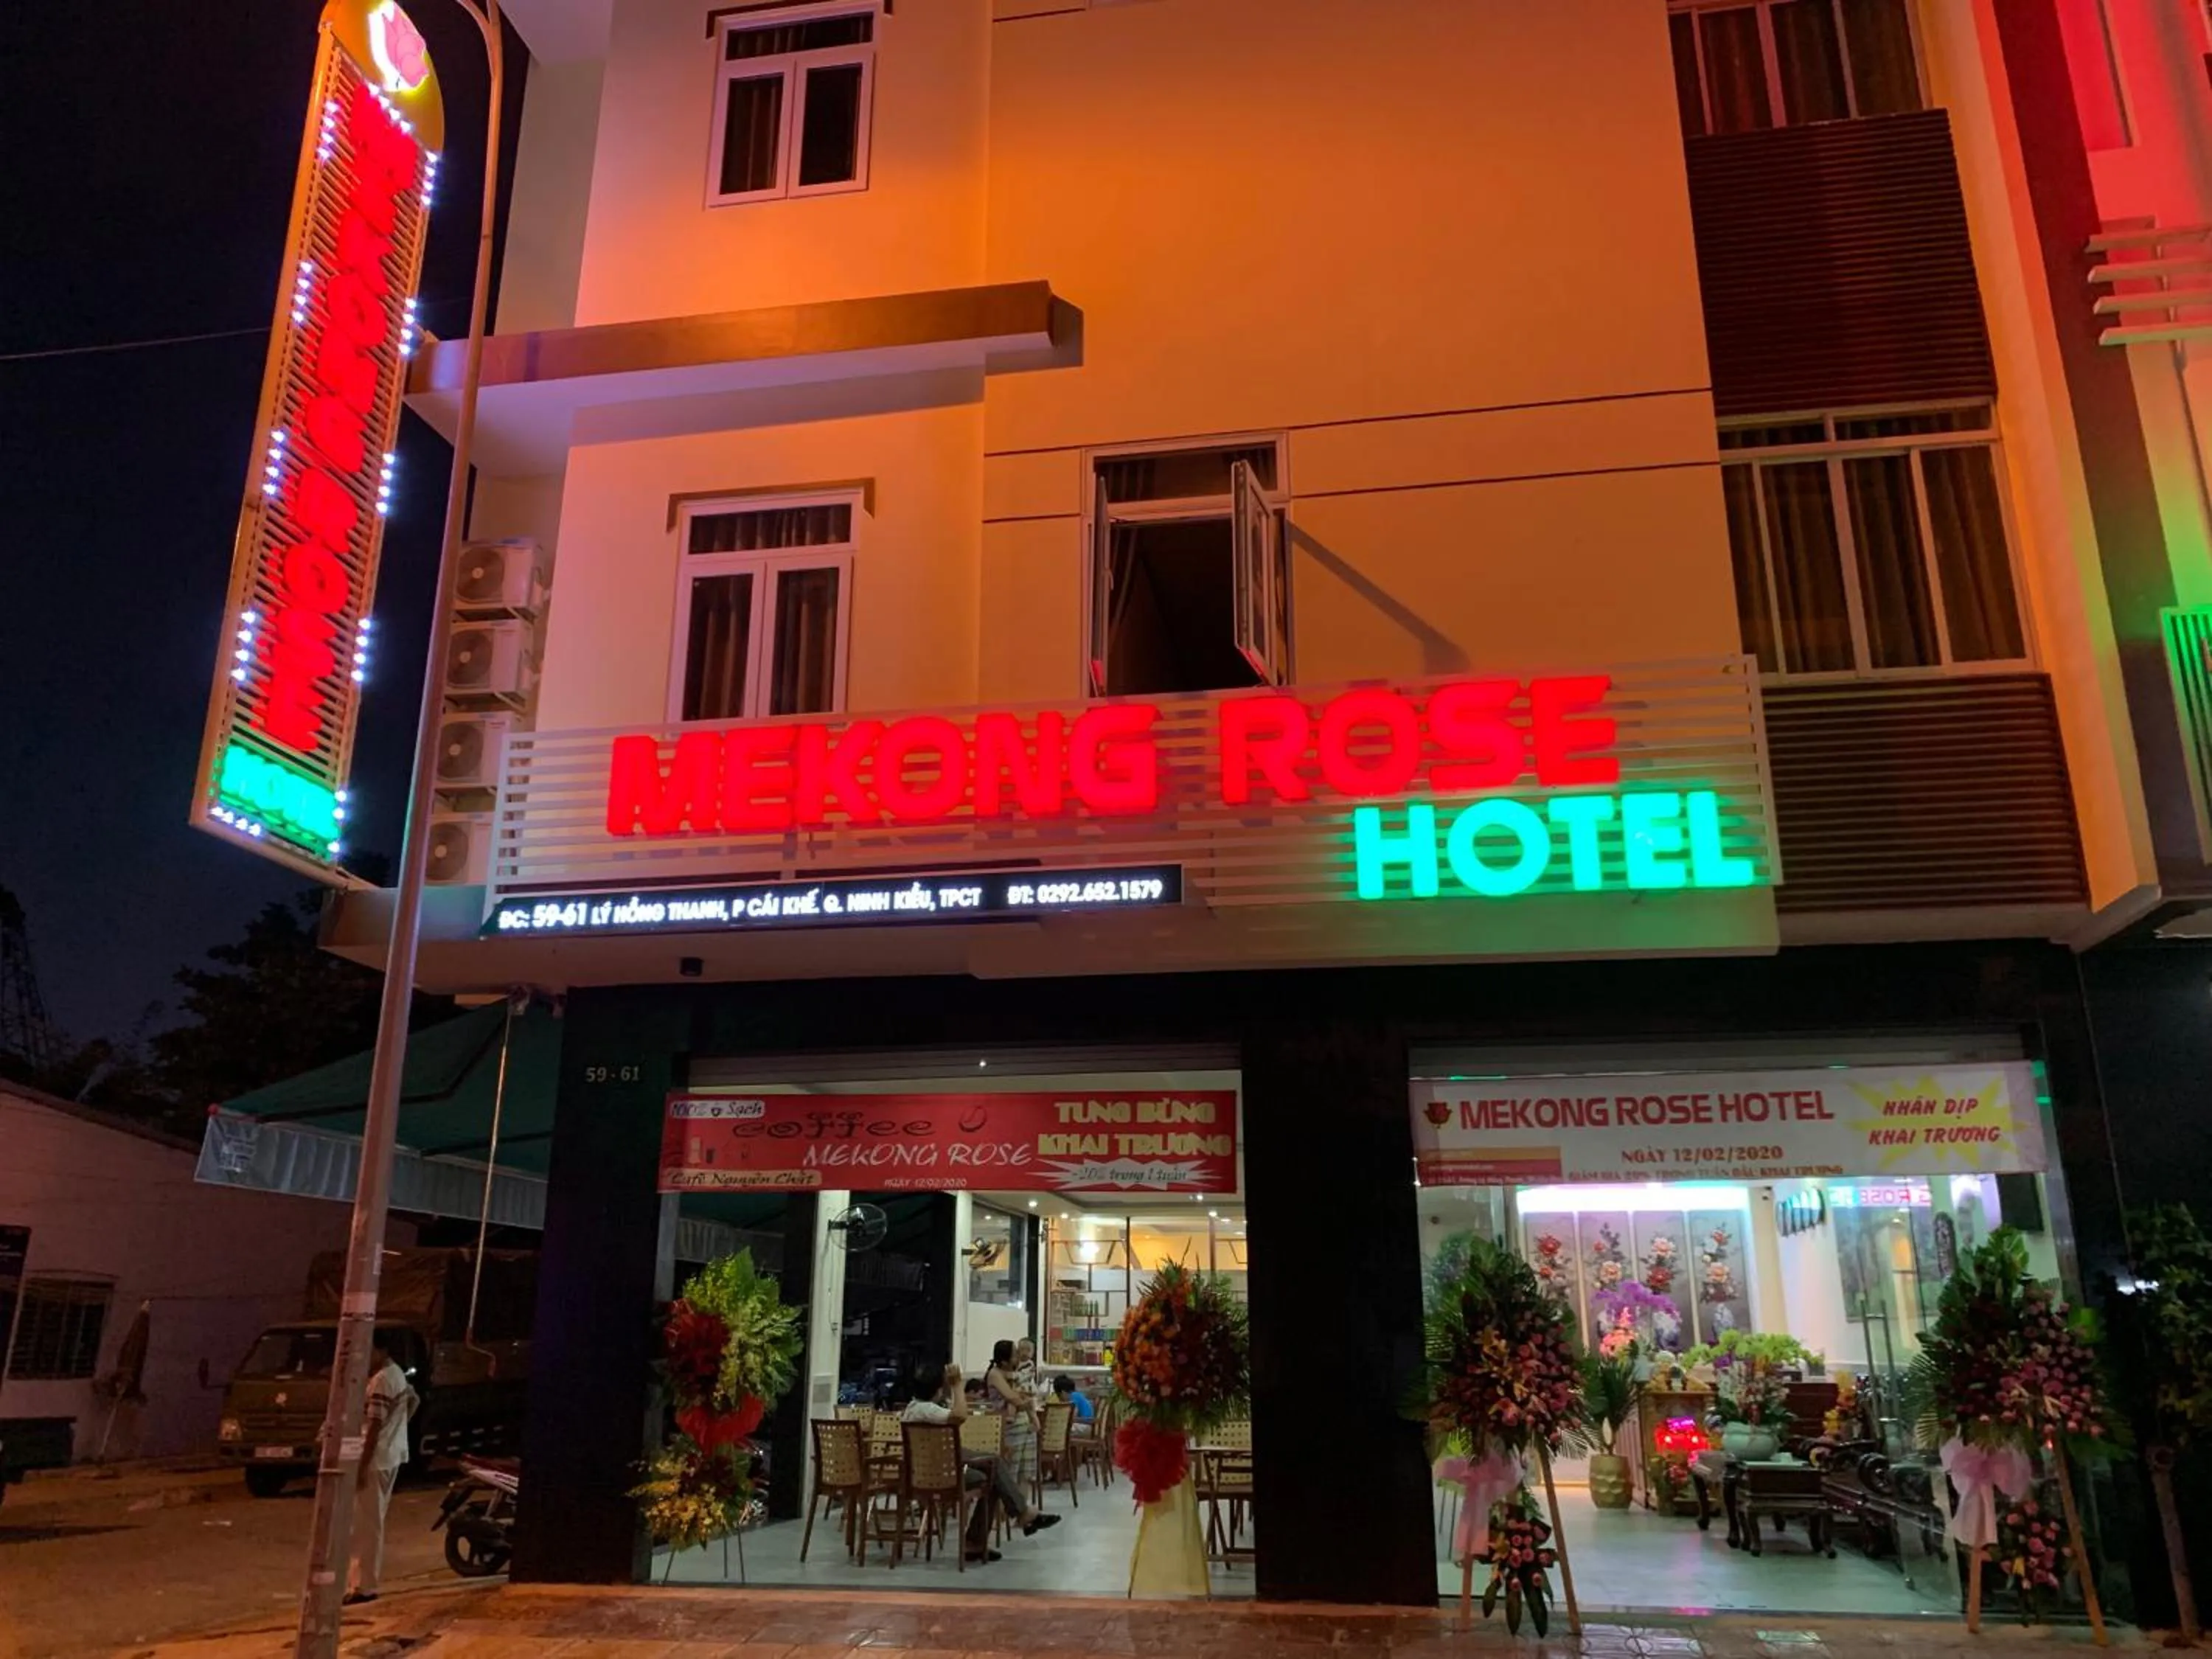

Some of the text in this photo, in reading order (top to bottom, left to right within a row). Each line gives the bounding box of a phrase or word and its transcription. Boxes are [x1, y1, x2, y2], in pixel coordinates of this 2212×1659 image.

[607, 675, 1619, 836] MEKONG ROSE
[1354, 791, 1755, 900] HOTEL
[532, 902, 587, 926] 59-61
[591, 901, 611, 924] LÝ
[747, 893, 779, 917] CÁI
[824, 894, 843, 913] Q.
[848, 892, 889, 911] NINH
[939, 888, 981, 906] TPCT
[1037, 880, 1162, 902] 0292.652.1579
[1460, 1091, 1834, 1130] MEKONG ROSE HOTEL
[1038, 1133, 1108, 1155] KHAI
[1869, 1129, 1916, 1145] KHAI
[947, 1142, 1033, 1166] ROSE
[1621, 1145, 1784, 1164] NGÀY 12/02/2020
